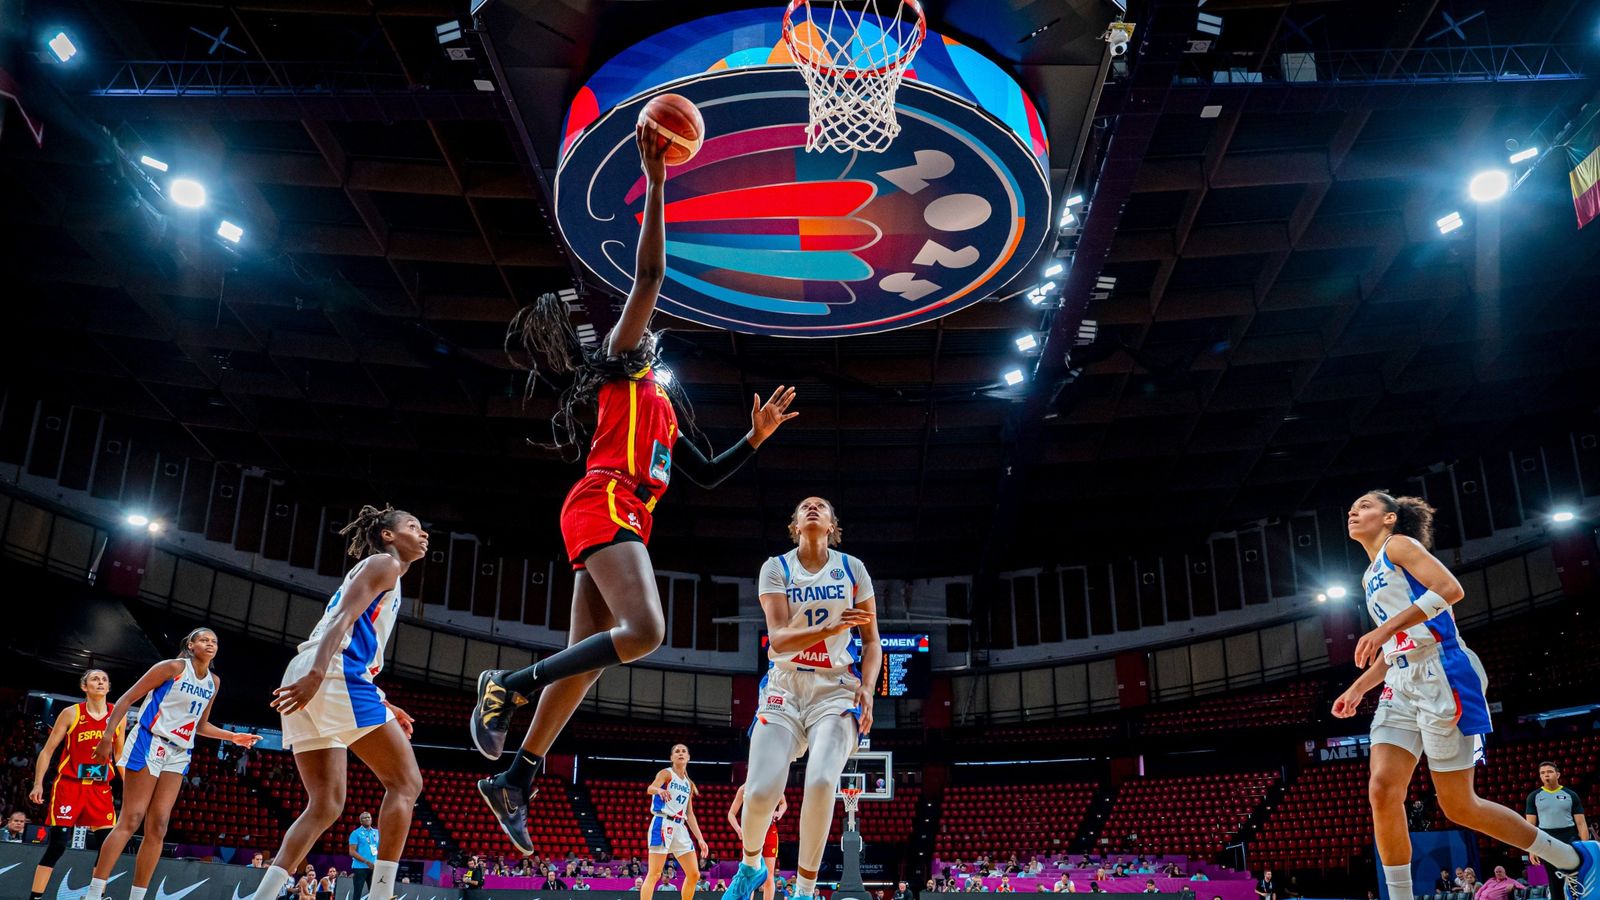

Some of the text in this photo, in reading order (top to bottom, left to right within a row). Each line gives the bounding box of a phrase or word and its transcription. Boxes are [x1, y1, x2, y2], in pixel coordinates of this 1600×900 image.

[786, 585, 845, 603] FRANCE
[804, 608, 829, 627] 12
[881, 638, 915, 647] OMEN
[798, 651, 830, 662] MAIF
[180, 682, 212, 700] FRANCE
[189, 700, 203, 716] 11
[78, 730, 106, 742] ESPA
[1320, 745, 1370, 761] DARE T
[676, 794, 687, 805] 47
